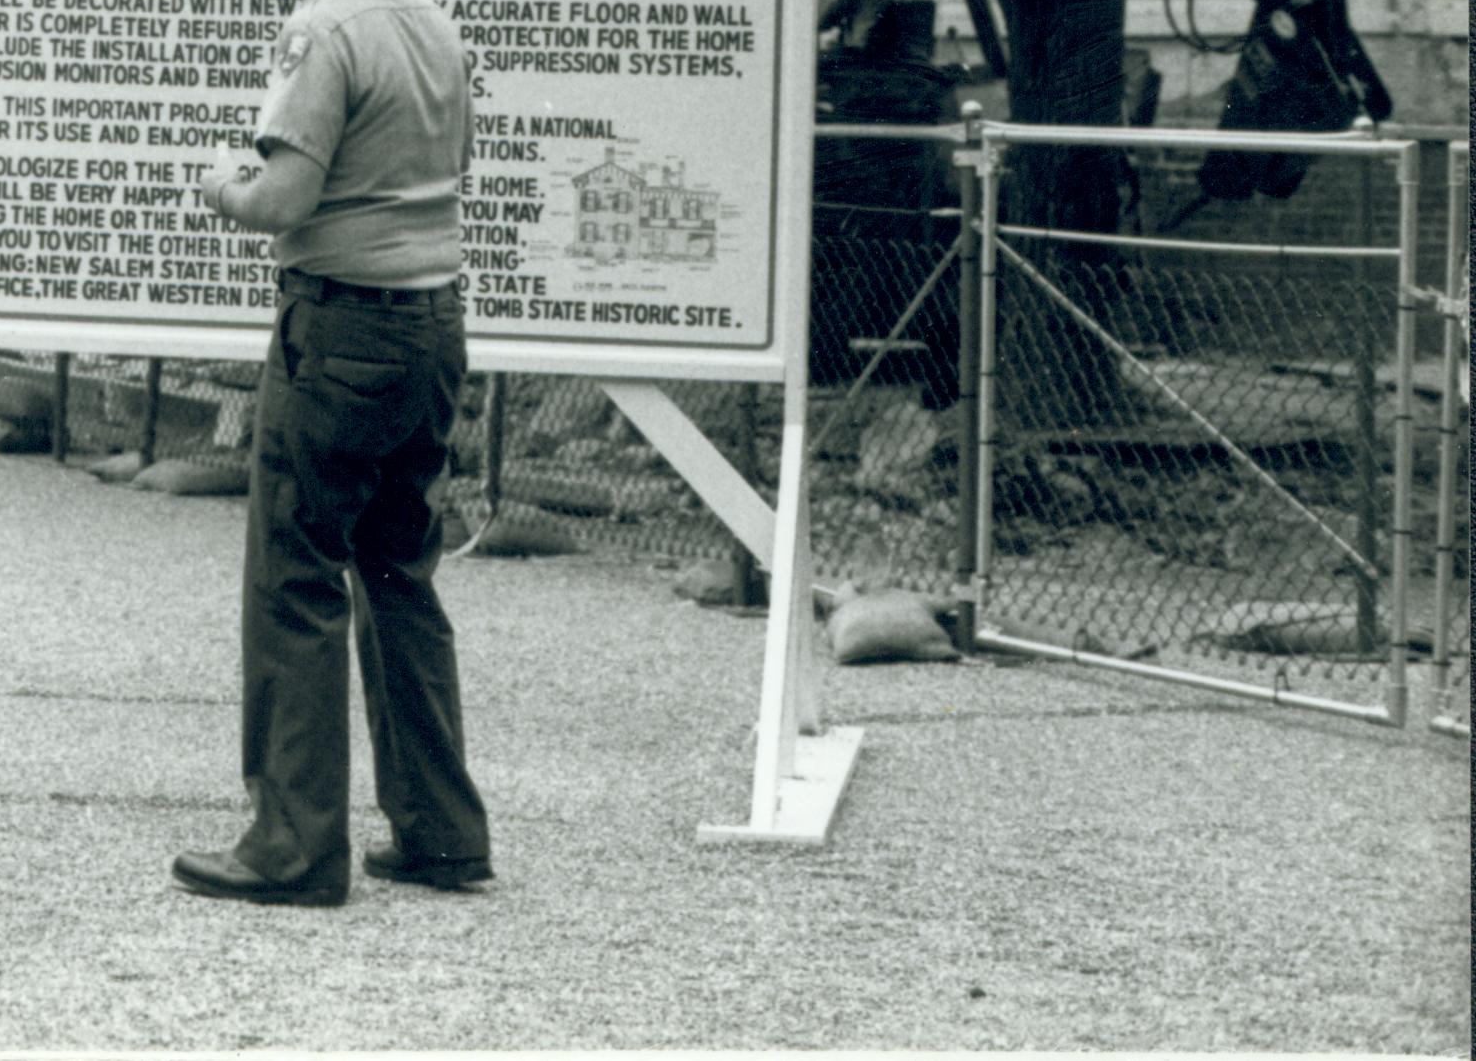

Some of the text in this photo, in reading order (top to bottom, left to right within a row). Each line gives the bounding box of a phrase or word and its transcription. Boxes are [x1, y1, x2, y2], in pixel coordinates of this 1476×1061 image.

[451, 0, 560, 21] ACCURATE
[569, 2, 639, 23] FLOOR
[646, 4, 687, 23] AND
[693, 5, 751, 25] WALL
[16, 12, 33, 31] IS
[40, 14, 169, 36] COMPLETELY
[460, 25, 588, 46] PROTECTION
[597, 28, 639, 48] FOR
[647, 29, 688, 50] THE
[696, 31, 753, 51] HOME
[49, 38, 85, 57] THE
[93, 41, 230, 63] INSTALLATION
[236, 45, 262, 65] OF
[483, 51, 618, 72] SUPPRESSION
[54, 63, 153, 84] MONITORS
[158, 67, 198, 85] AND
[3, 96, 45, 115] THIS
[53, 99, 163, 119] IMPORTANT
[169, 103, 260, 124] PROJECT
[512, 116, 525, 135] A
[530, 117, 618, 138] NATIONAL
[16, 121, 48, 141] ITS
[54, 122, 90, 141] USE
[98, 125, 139, 143] AND
[86, 159, 127, 180] FOR
[134, 161, 173, 181] THE
[480, 176, 544, 197] HOME.
[11, 205, 45, 224] THE
[52, 207, 103, 227] HOME
[110, 210, 136, 228] OR
[141, 210, 176, 230] THE
[30, 182, 56, 200] BE
[64, 184, 115, 202] VERY
[123, 186, 184, 206] HAPPY
[461, 200, 497, 221] YOU
[502, 202, 543, 222] MAY
[36, 230, 60, 250] TO
[63, 231, 110, 251] VISIT
[118, 234, 153, 254] THE
[158, 236, 221, 256] OTHER
[36, 255, 81, 273] NEW
[89, 257, 153, 277] SALEM
[160, 259, 219, 280] STATE
[478, 273, 545, 294] STATE
[41, 278, 76, 298] THE
[82, 281, 140, 300] GREAT
[148, 284, 241, 304] WESTERN
[473, 297, 522, 317] TOMB
[528, 299, 585, 320] STATE
[592, 303, 679, 324] HISTORIC
[685, 306, 741, 327] SITE.
